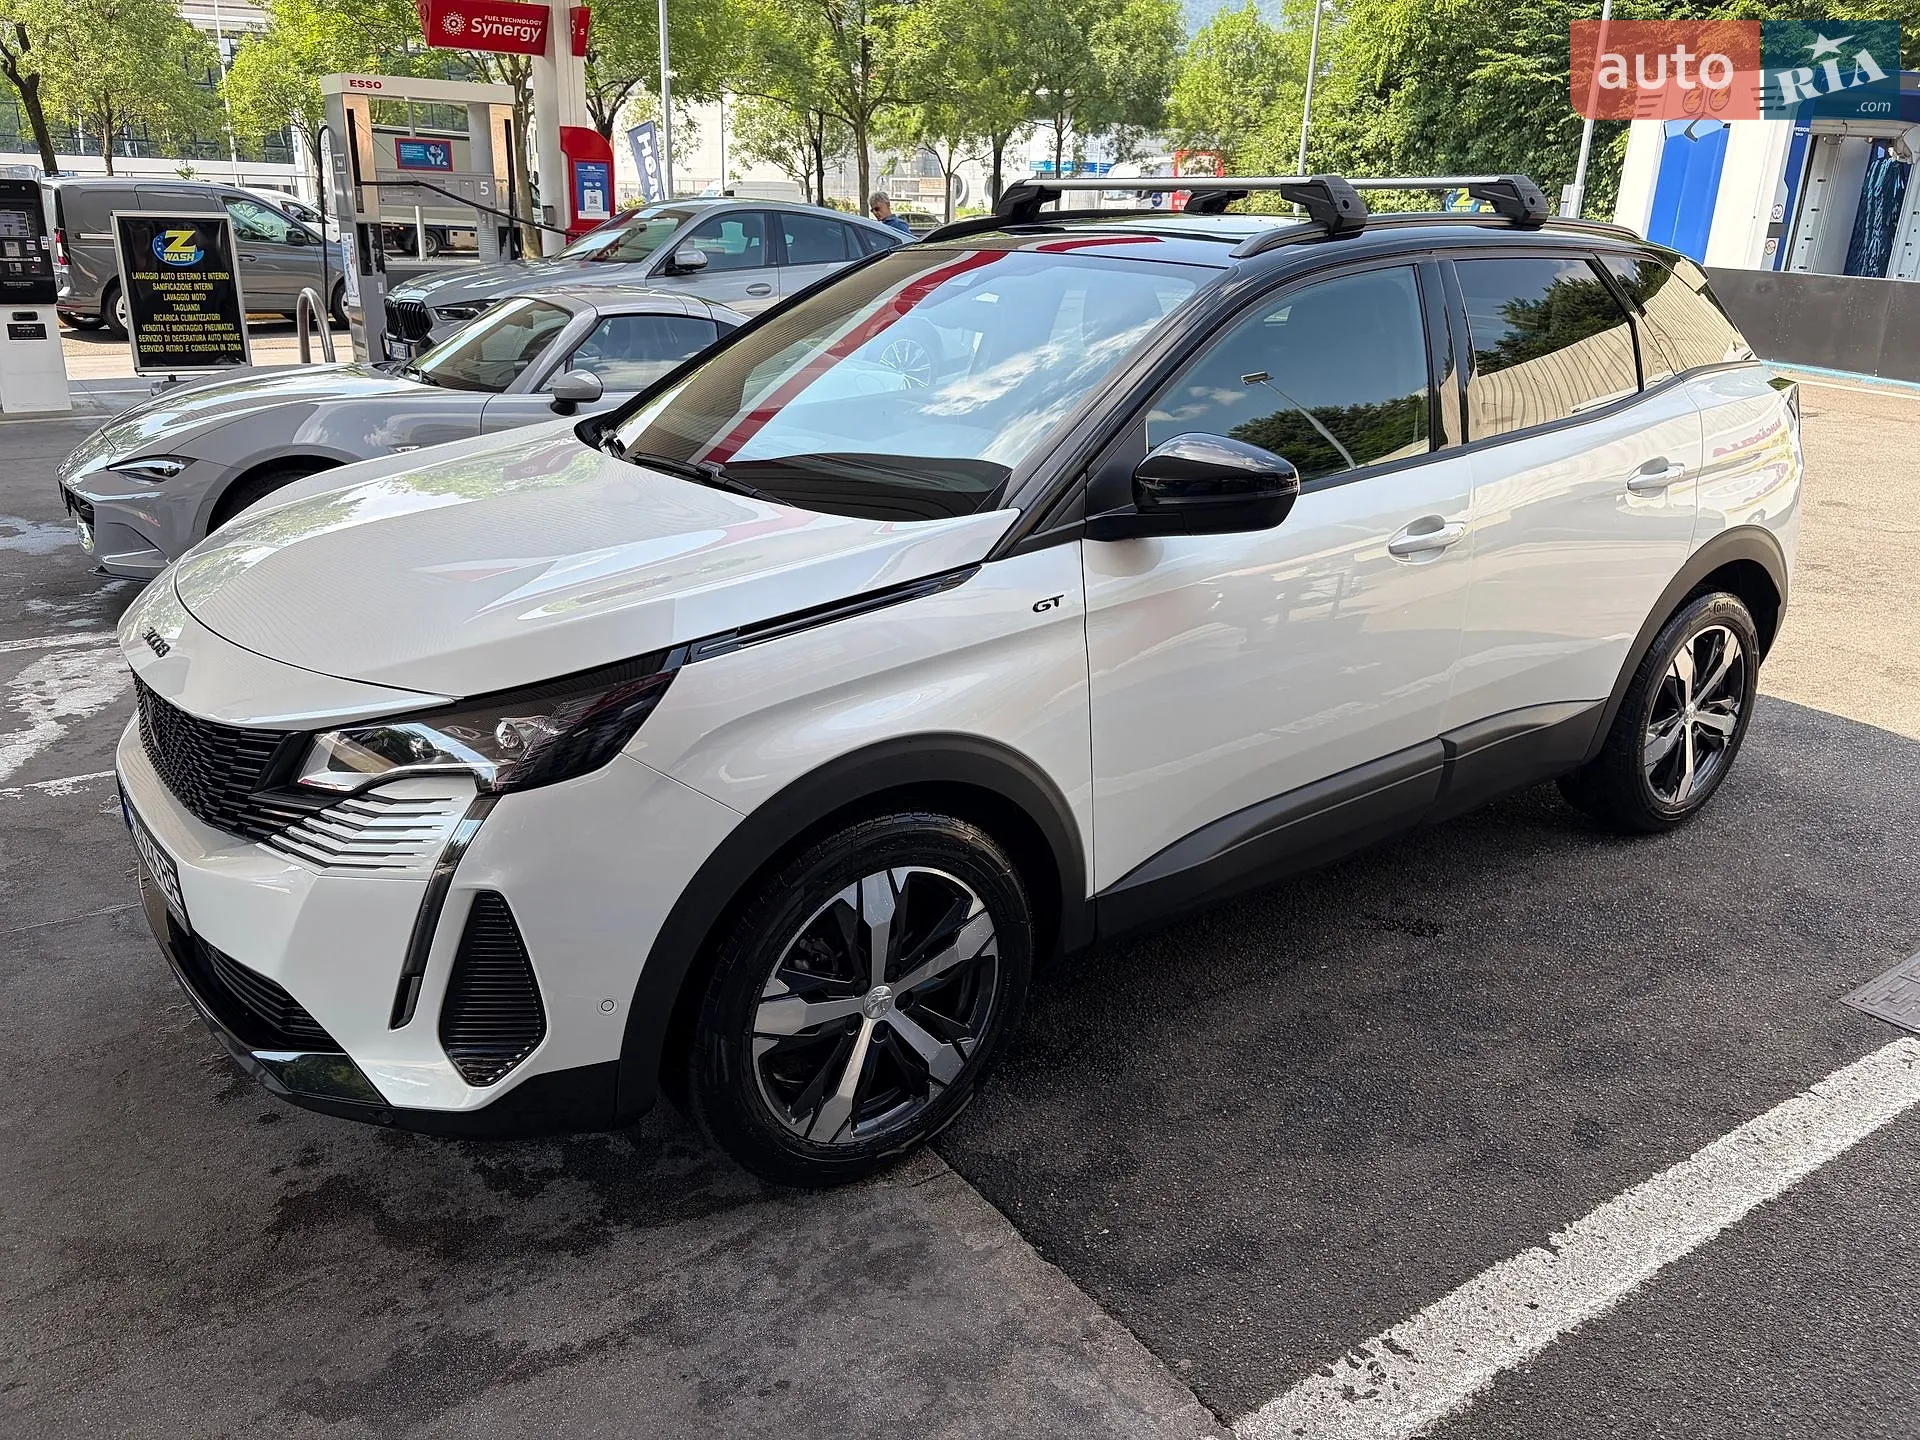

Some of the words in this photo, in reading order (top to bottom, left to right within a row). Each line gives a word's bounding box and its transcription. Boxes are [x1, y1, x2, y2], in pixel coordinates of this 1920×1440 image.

[501, 16, 542, 26] TECHNOLOGY
[471, 17, 541, 42] Synergy
[350, 79, 382, 89] ESSO
[480, 181, 489, 195] 5
[164, 230, 196, 252] Z
[163, 252, 195, 262] WASH
[132, 272, 159, 280] LAVAGGIO
[161, 272, 176, 280] AUTO
[177, 272, 201, 280] ESTERNO
[208, 272, 229, 280] INTERNO
[152, 282, 192, 290] SANIFICAZIONE
[163, 293, 190, 301] LAVAGGIO
[191, 293, 206, 301] MOTO
[172, 303, 200, 311] TAGLIANDI
[153, 313, 179, 321] RICARICA
[180, 313, 220, 321] CLIMATIZZATORI
[141, 324, 165, 332] VENDITA
[204, 323, 234, 331] PNEUMATICI
[138, 334, 162, 342] SERVIZIO
[164, 334, 171, 342] DI
[171, 334, 206, 342] DECERATURA
[207, 333, 221, 341] AUTO
[222, 333, 240, 341] NUOVE
[165, 344, 183, 352] RITIRO
[185, 344, 190, 352] E
[190, 344, 219, 352] CONSEGNA
[220, 343, 226, 351] IN
[227, 343, 242, 351] ZONA
[1032, 594, 1064, 612] GT
[142, 627, 171, 658] 3008
